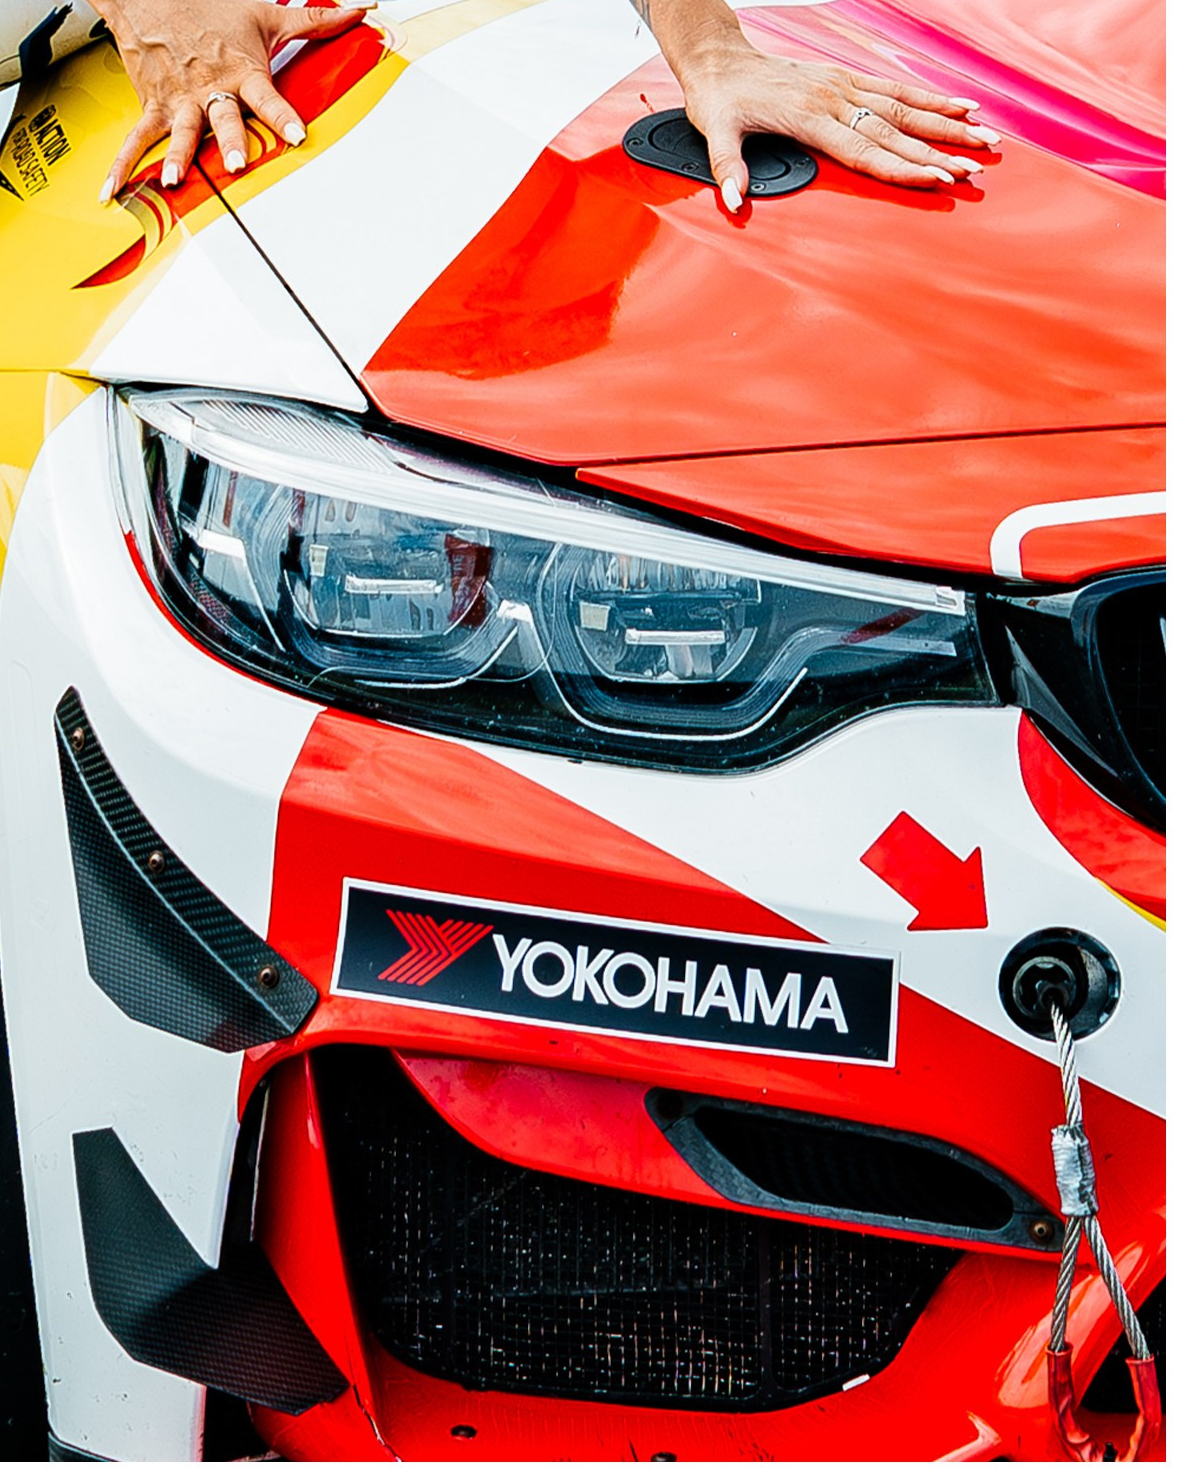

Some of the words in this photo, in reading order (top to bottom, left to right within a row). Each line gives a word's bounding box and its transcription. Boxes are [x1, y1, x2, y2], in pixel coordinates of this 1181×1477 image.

[33, 118, 71, 166] ACTION
[19, 158, 50, 196] SAFETY
[492, 933, 849, 1034] YOKOHAMA
